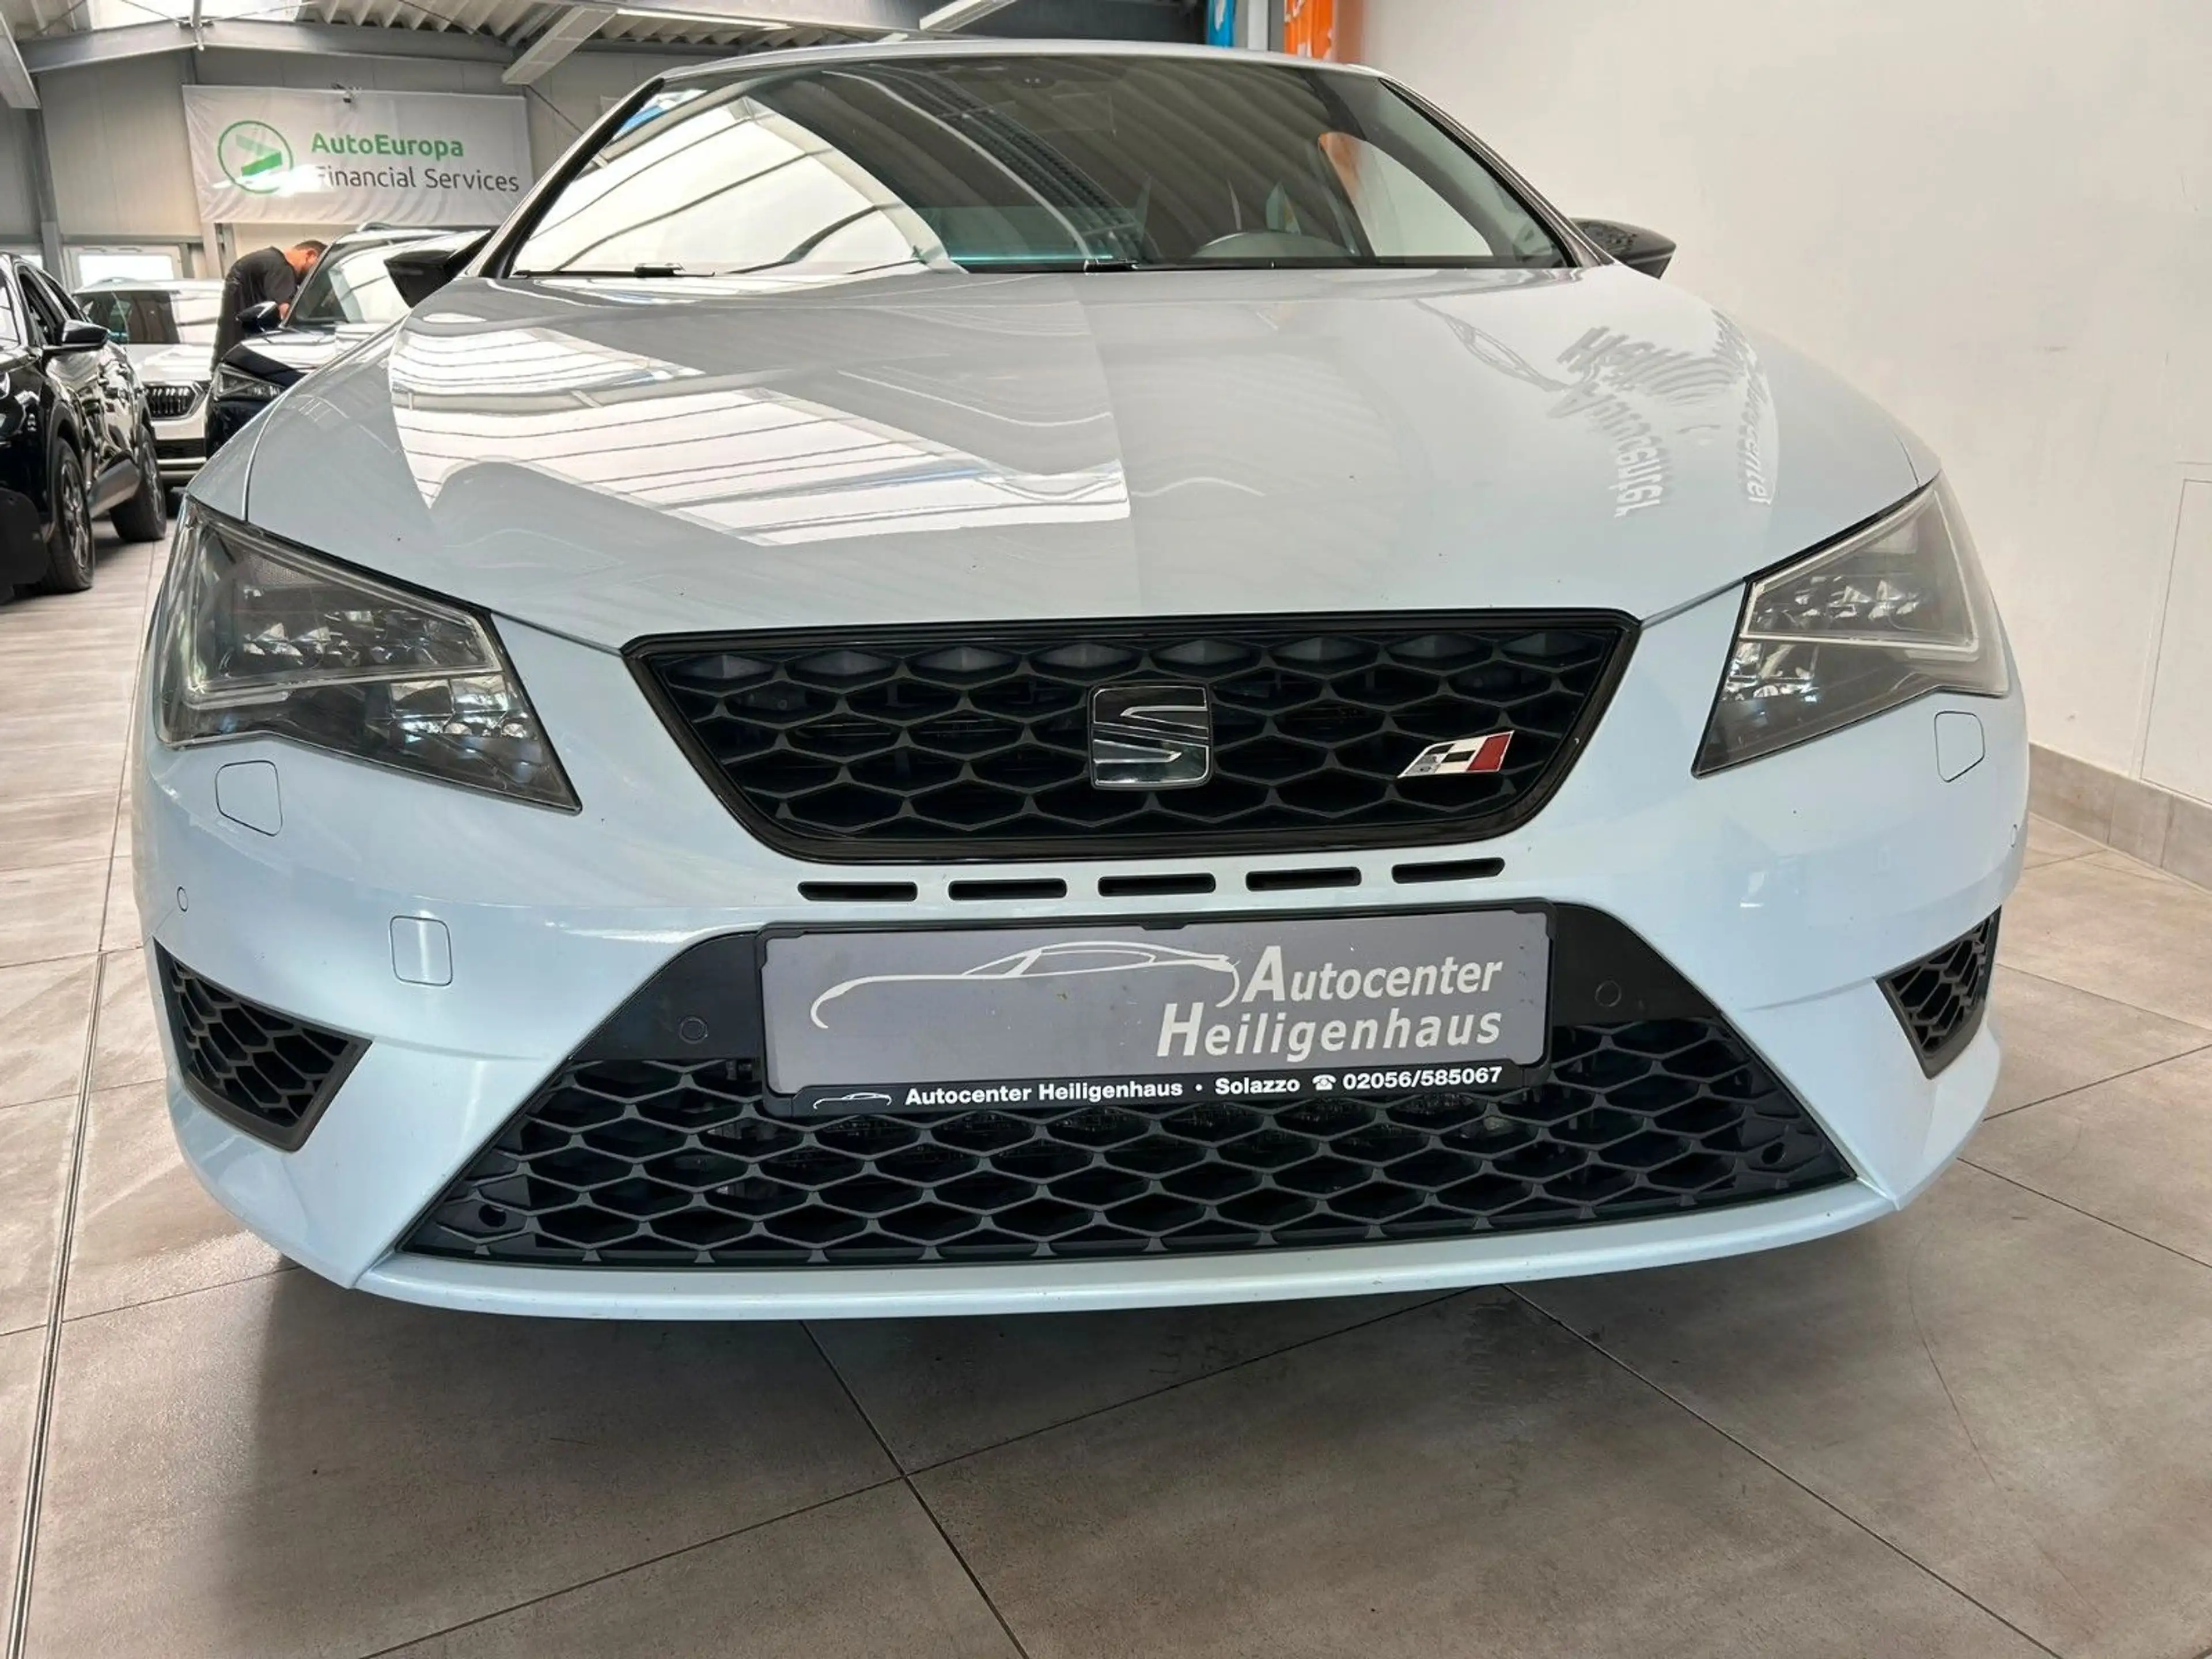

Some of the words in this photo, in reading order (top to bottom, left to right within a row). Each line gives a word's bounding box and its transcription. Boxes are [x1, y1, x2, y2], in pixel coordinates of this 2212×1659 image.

[312, 132, 464, 161] AutoEuropa
[425, 168, 520, 192] Services
[1241, 945, 1503, 1002] Autocenter
[1156, 1002, 1502, 1063] Heiligenhaus
[905, 1085, 1033, 1105] Autocenter
[1039, 1080, 1183, 1103] Heiligenhaus
[1214, 1076, 1301, 1095] Solazzo
[1342, 1066, 1502, 1090] 02056/585067
